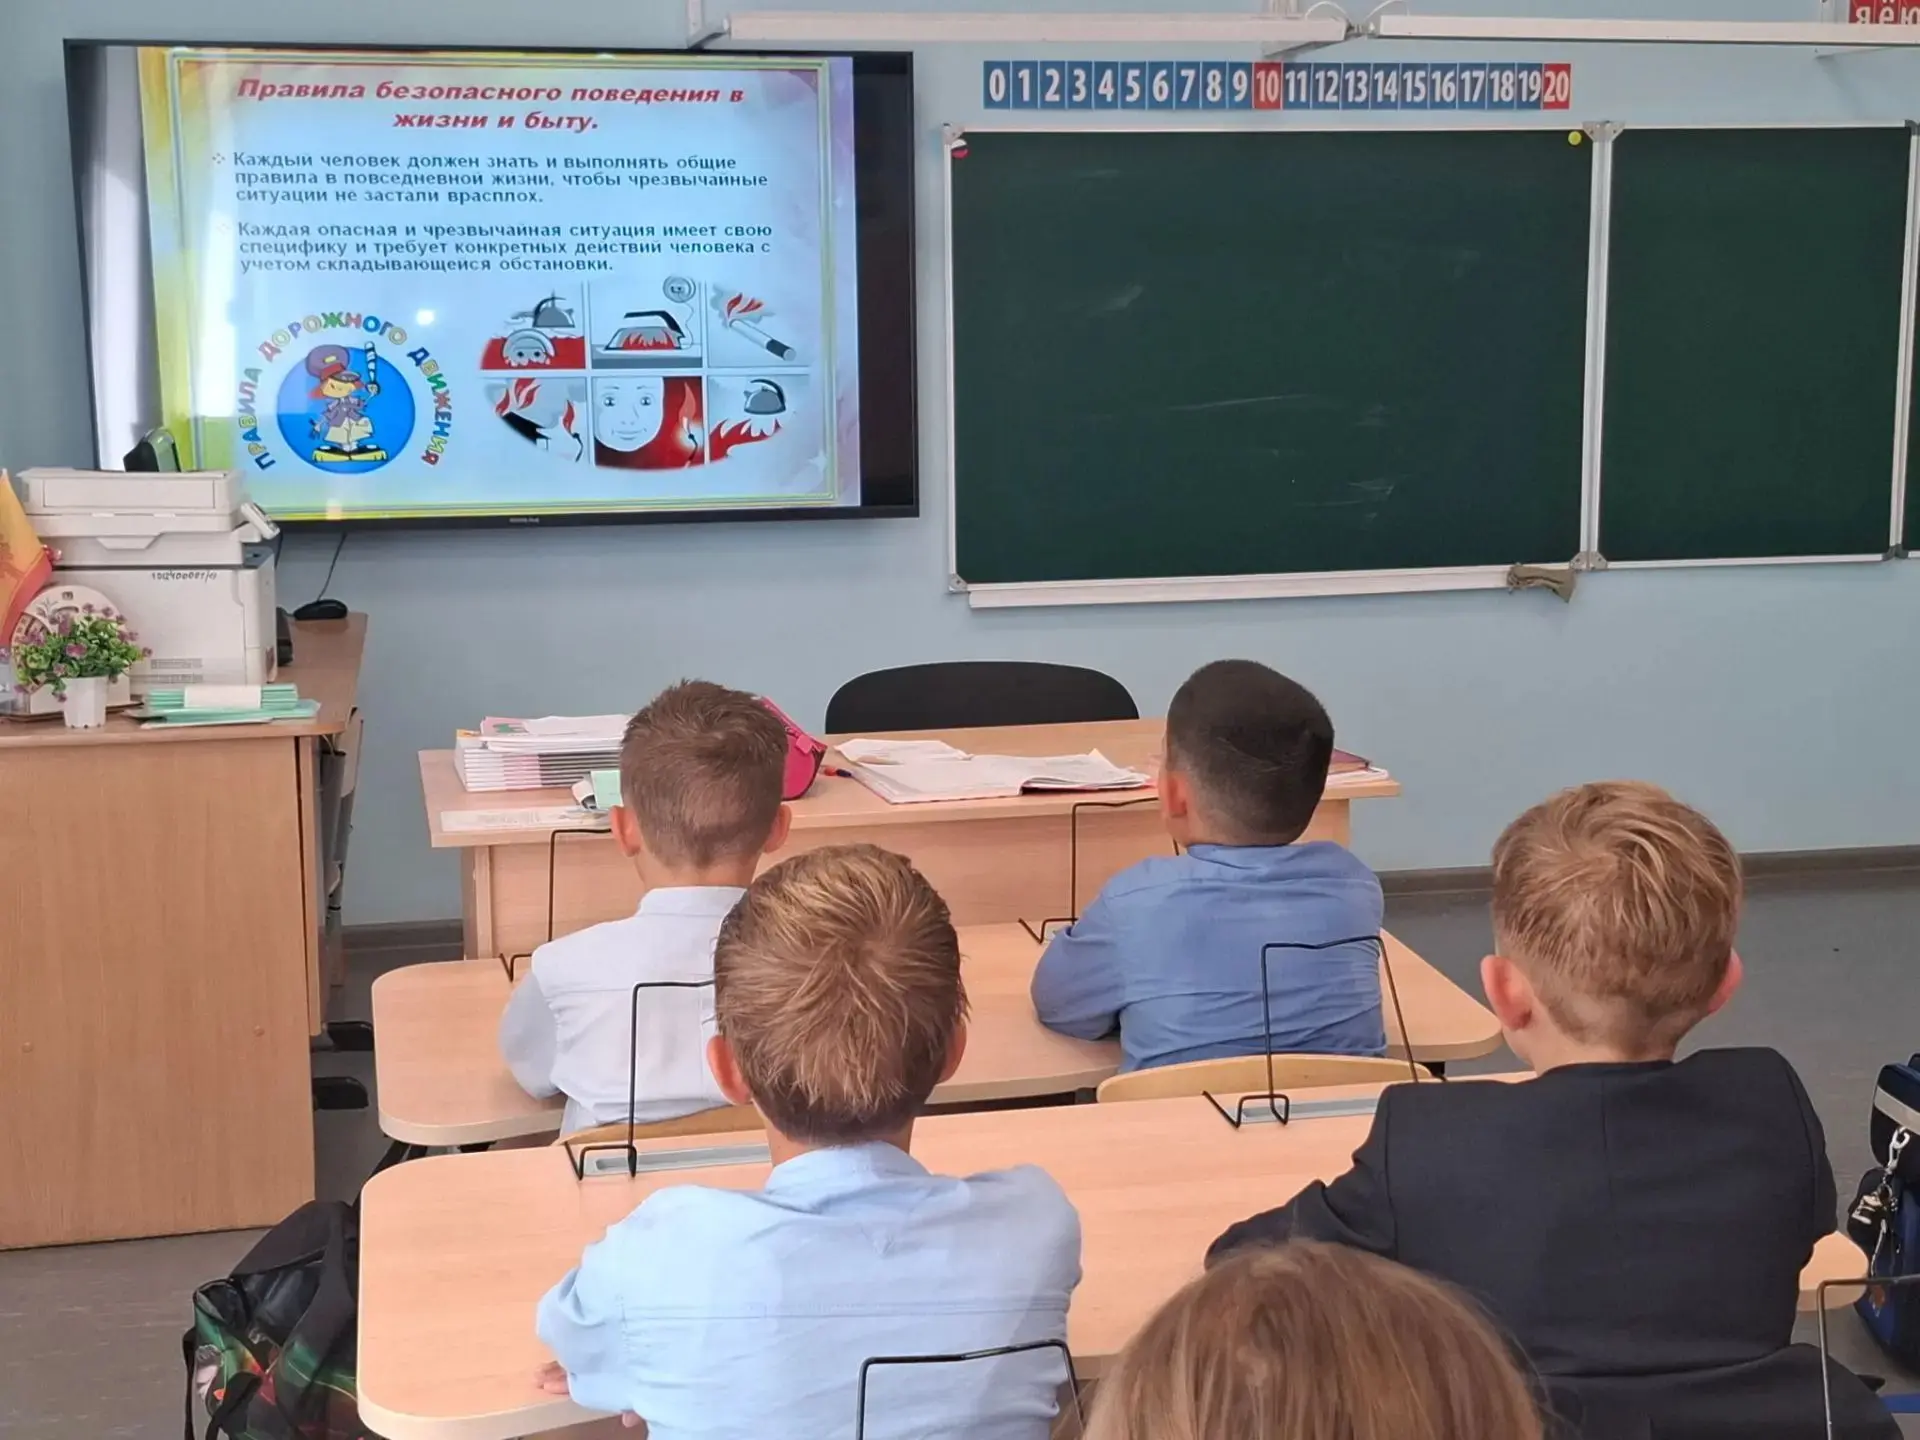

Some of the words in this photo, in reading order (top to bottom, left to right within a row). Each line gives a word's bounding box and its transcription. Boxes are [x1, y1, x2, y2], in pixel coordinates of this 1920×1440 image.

[237, 78, 366, 102] Правила
[375, 80, 563, 105] безопасного
[570, 88, 721, 105] поведения
[729, 89, 744, 103] в
[989, 68, 1006, 102] 0
[1018, 68, 1030, 102] 1
[1045, 68, 1060, 102] 2
[1072, 68, 1087, 102] 3
[1098, 69, 1114, 102] 4
[1125, 69, 1141, 103] 5
[1152, 69, 1169, 102] 6
[1180, 69, 1196, 102] 7
[1206, 69, 1222, 102] 8
[1232, 69, 1248, 103] 9
[1256, 70, 1280, 103] 10
[1285, 70, 1307, 103] 11
[1315, 70, 1339, 103] 12
[1344, 70, 1368, 103] 13
[1371, 70, 1398, 103] 14
[1403, 70, 1426, 103] 15
[1431, 70, 1456, 103] 16
[1460, 70, 1485, 103] 17
[1489, 70, 1514, 103] 18
[1518, 70, 1542, 102] 19
[1542, 70, 1570, 103] 20
[393, 113, 489, 128] жизни
[497, 115, 515, 129] и
[524, 110, 598, 134] быту.
[320, 155, 401, 168] человек
[406, 156, 480, 170] должен
[487, 156, 539, 169] знать
[546, 157, 557, 169] и
[563, 157, 669, 169] выполнять
[676, 155, 737, 172] общие
[235, 172, 319, 188] правила
[325, 173, 338, 185] в
[343, 170, 484, 187] повседневной
[562, 171, 621, 186] чтобы
[628, 175, 768, 190] чрезвычайные
[236, 190, 328, 205] ситуации
[335, 190, 358, 202] не
[364, 190, 439, 202] застали
[447, 191, 543, 206] врасплох.
[238, 222, 311, 239] Каждая
[317, 225, 397, 237] опасная
[405, 225, 417, 237] и
[423, 223, 561, 241] чрезвычайная
[569, 225, 655, 241] ситуация
[663, 225, 717, 237] имеет
[724, 225, 773, 237] свою
[239, 239, 348, 258] специфику
[355, 242, 367, 254] и
[373, 239, 448, 258] требует
[454, 242, 567, 258] конкретных
[574, 237, 662, 257] действий
[669, 242, 755, 254] человека
[760, 242, 771, 253] с
[240, 257, 311, 275] учетом
[499, 254, 613, 271] обстановки.
[238, 367, 276, 471] ПРАВИЛА
[258, 311, 407, 363] ДОРОЖНОГО
[406, 347, 452, 466] ДВИЖЕНИЯ
